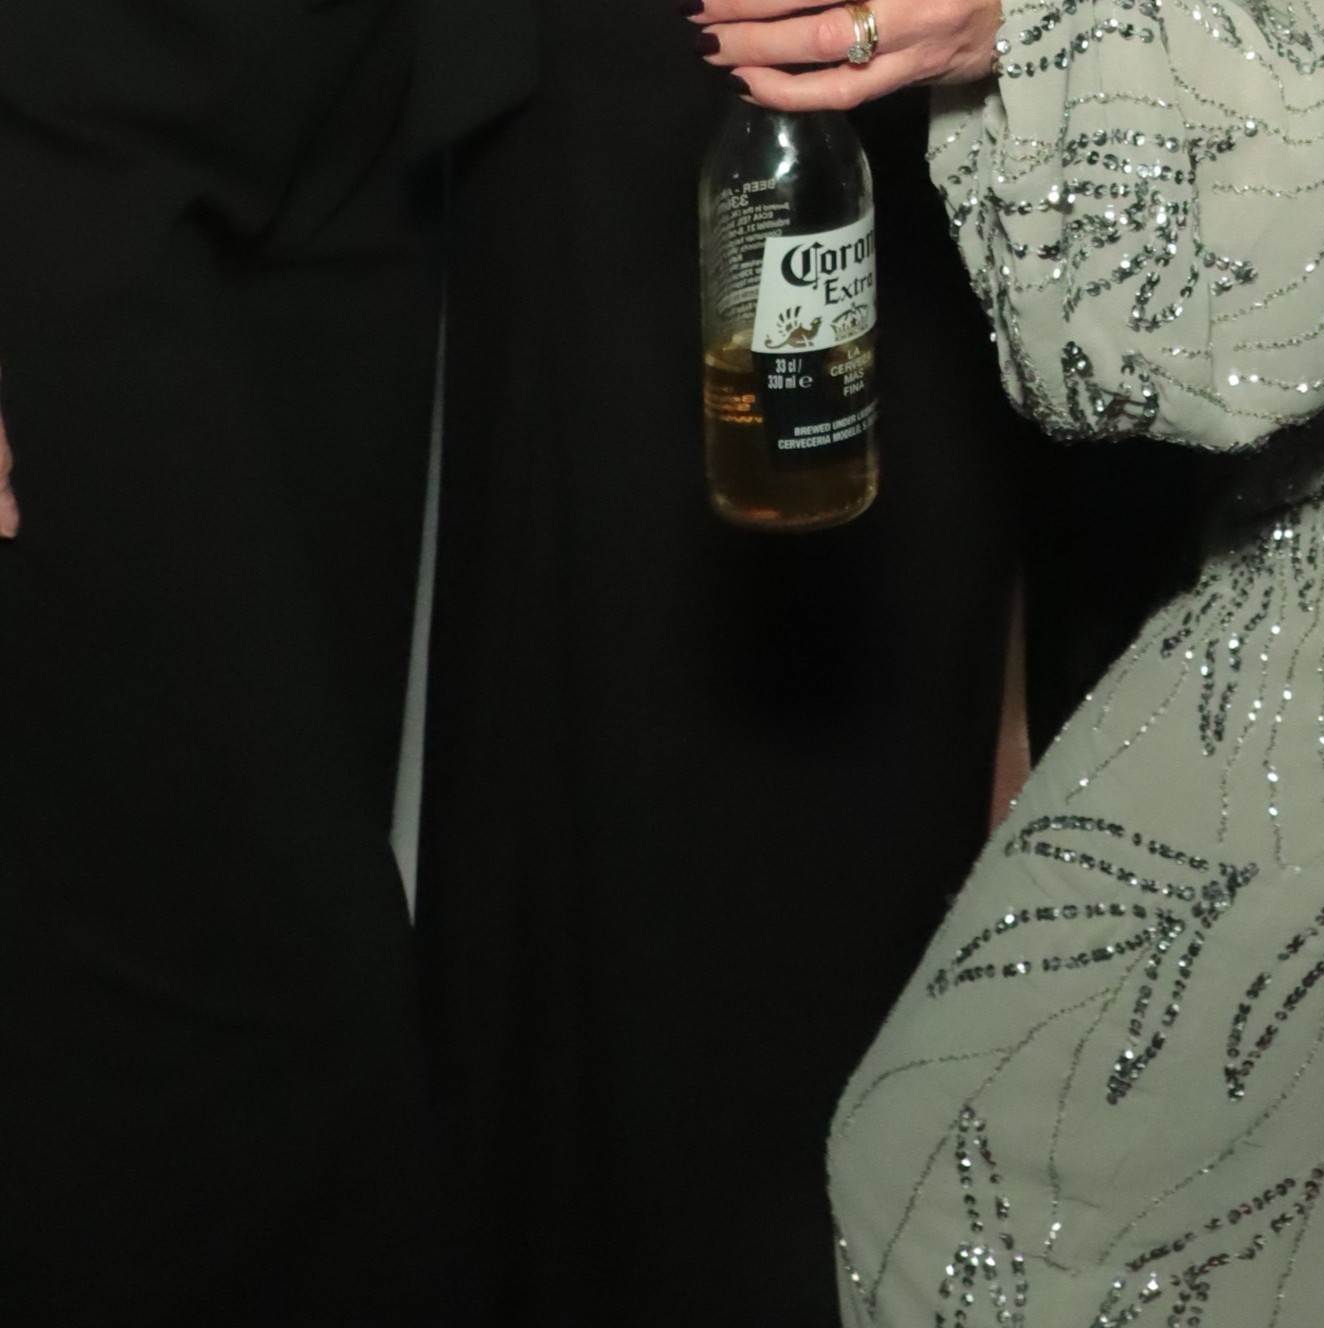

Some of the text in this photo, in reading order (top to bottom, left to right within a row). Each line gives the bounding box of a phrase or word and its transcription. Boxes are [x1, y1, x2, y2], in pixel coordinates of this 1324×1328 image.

[781, 229, 875, 290] Coron
[824, 272, 873, 305] Extra
[775, 358, 787, 373] 33
[768, 375, 783, 389] 330
[785, 375, 796, 389] ml
[843, 380, 864, 397] FINA
[794, 423, 831, 436] BREWED
[832, 414, 856, 431] UNDER
[778, 435, 831, 450] CERVECERIA
